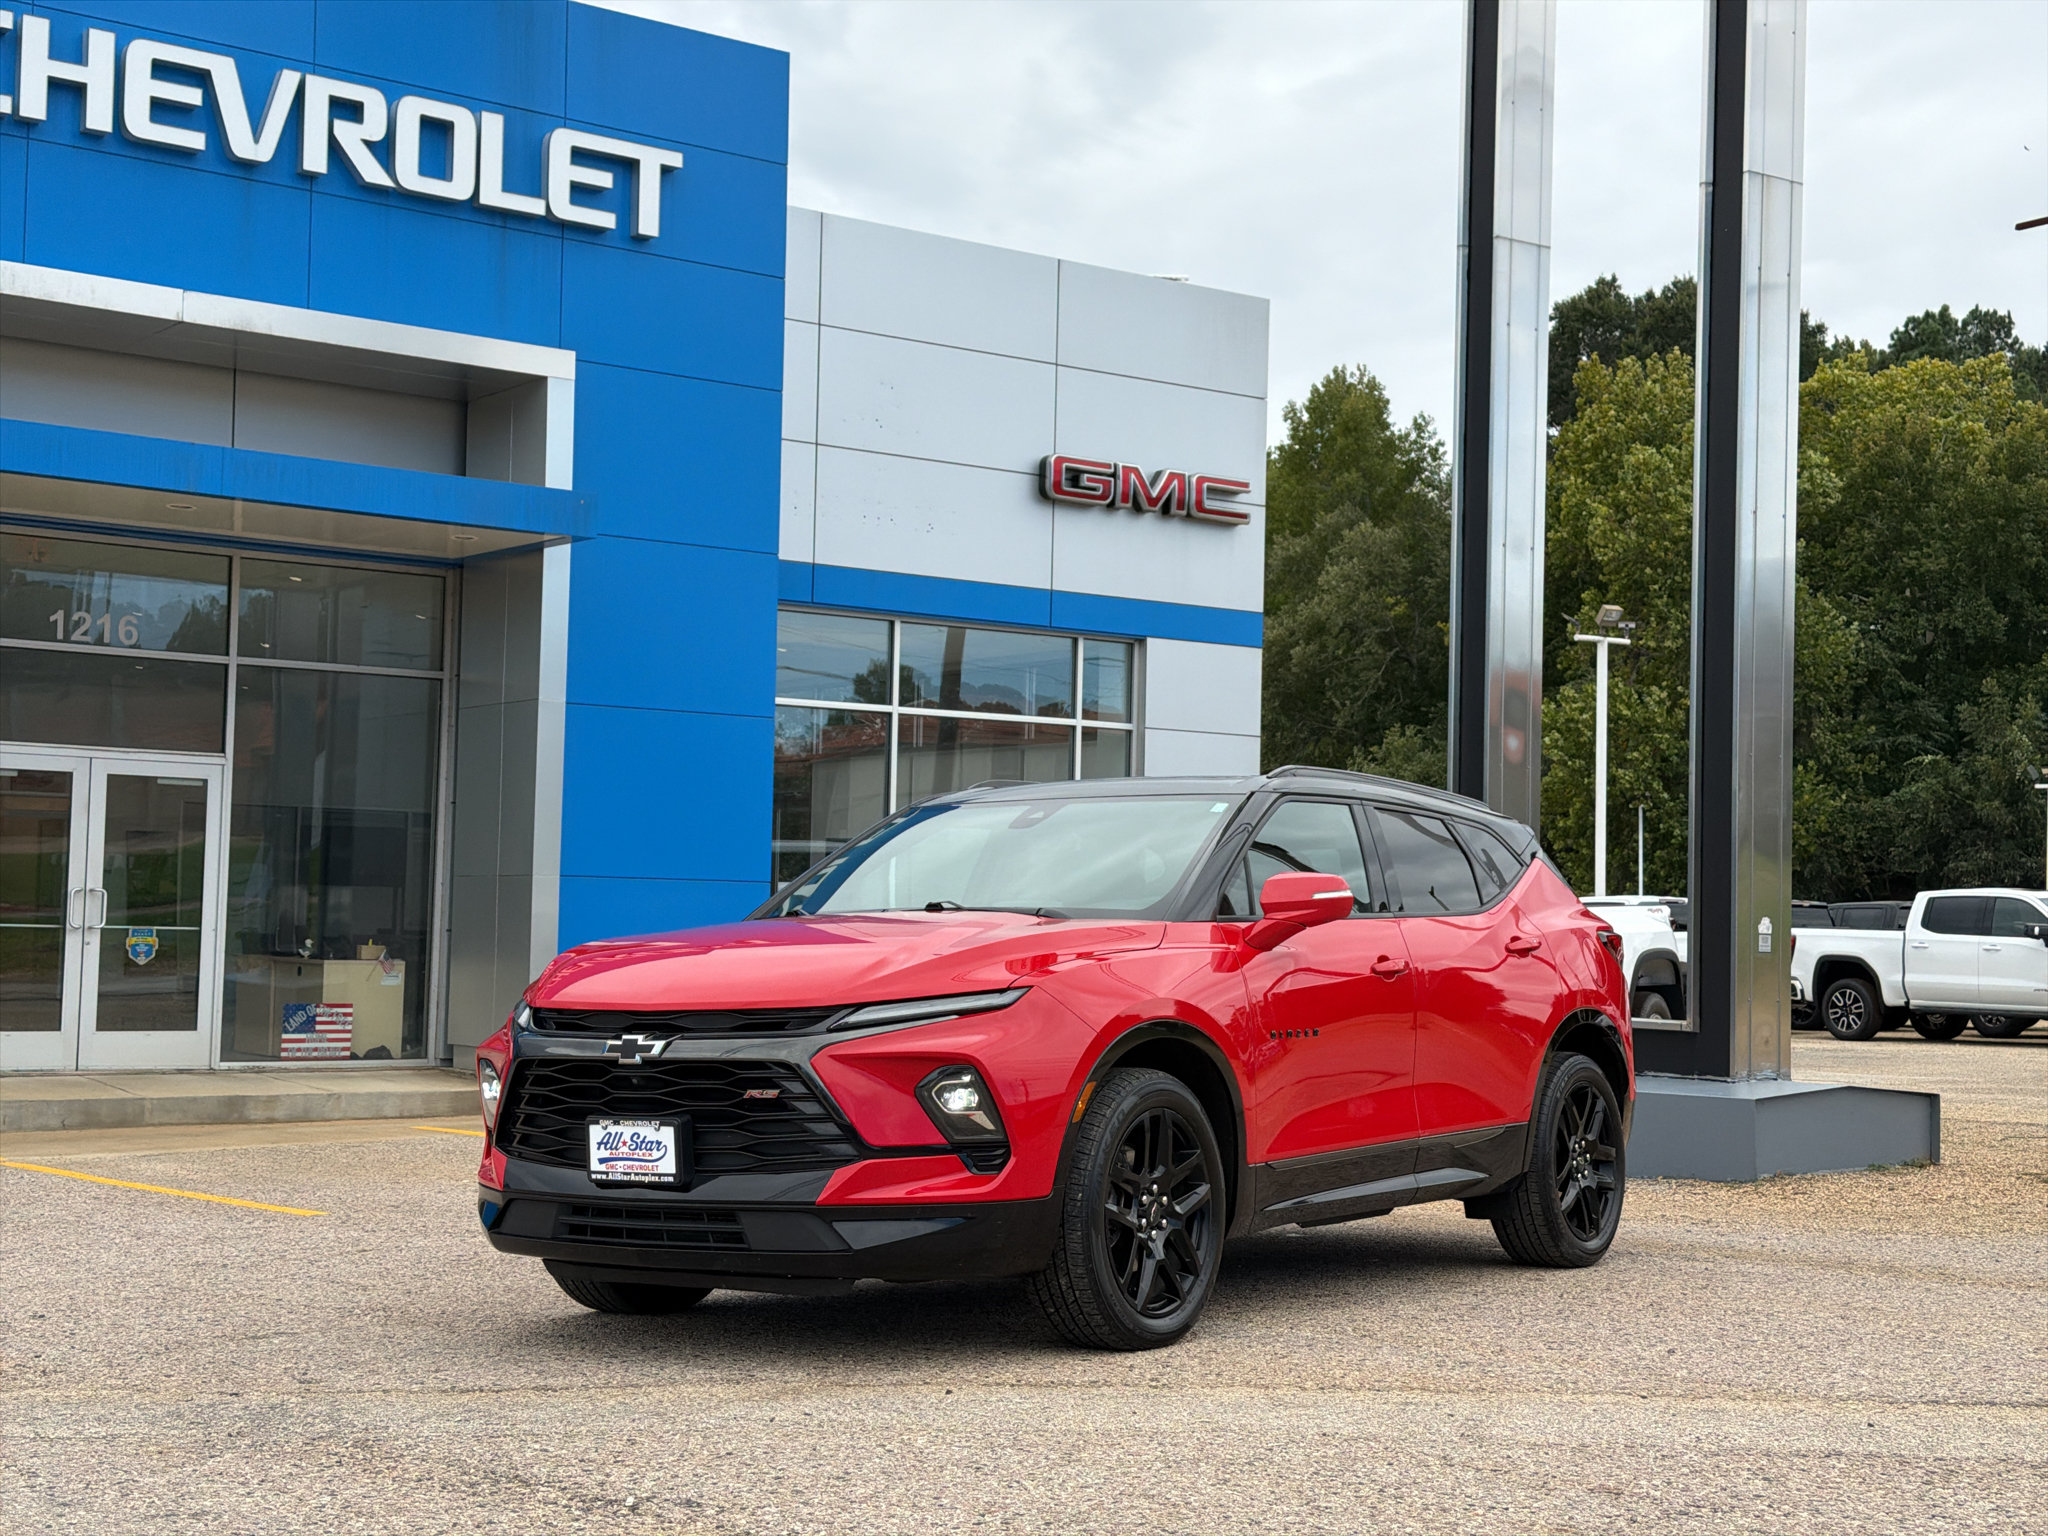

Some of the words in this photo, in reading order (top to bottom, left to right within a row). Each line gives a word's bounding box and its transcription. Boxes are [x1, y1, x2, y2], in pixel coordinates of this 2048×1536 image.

[0, 9, 683, 240] HEVROLET
[1040, 454, 1251, 525] GMC
[49, 609, 139, 646] 1216
[284, 1011, 308, 1032] LAND
[306, 1004, 317, 1017] OF
[743, 1089, 782, 1099] RS
[599, 1119, 614, 1127] GMC
[619, 1120, 660, 1128] CHEVROLET
[605, 1163, 619, 1171] GMC
[623, 1164, 659, 1172] CHEVROLET
[591, 1172, 674, 1183] www.AllStarAutoplex.com
